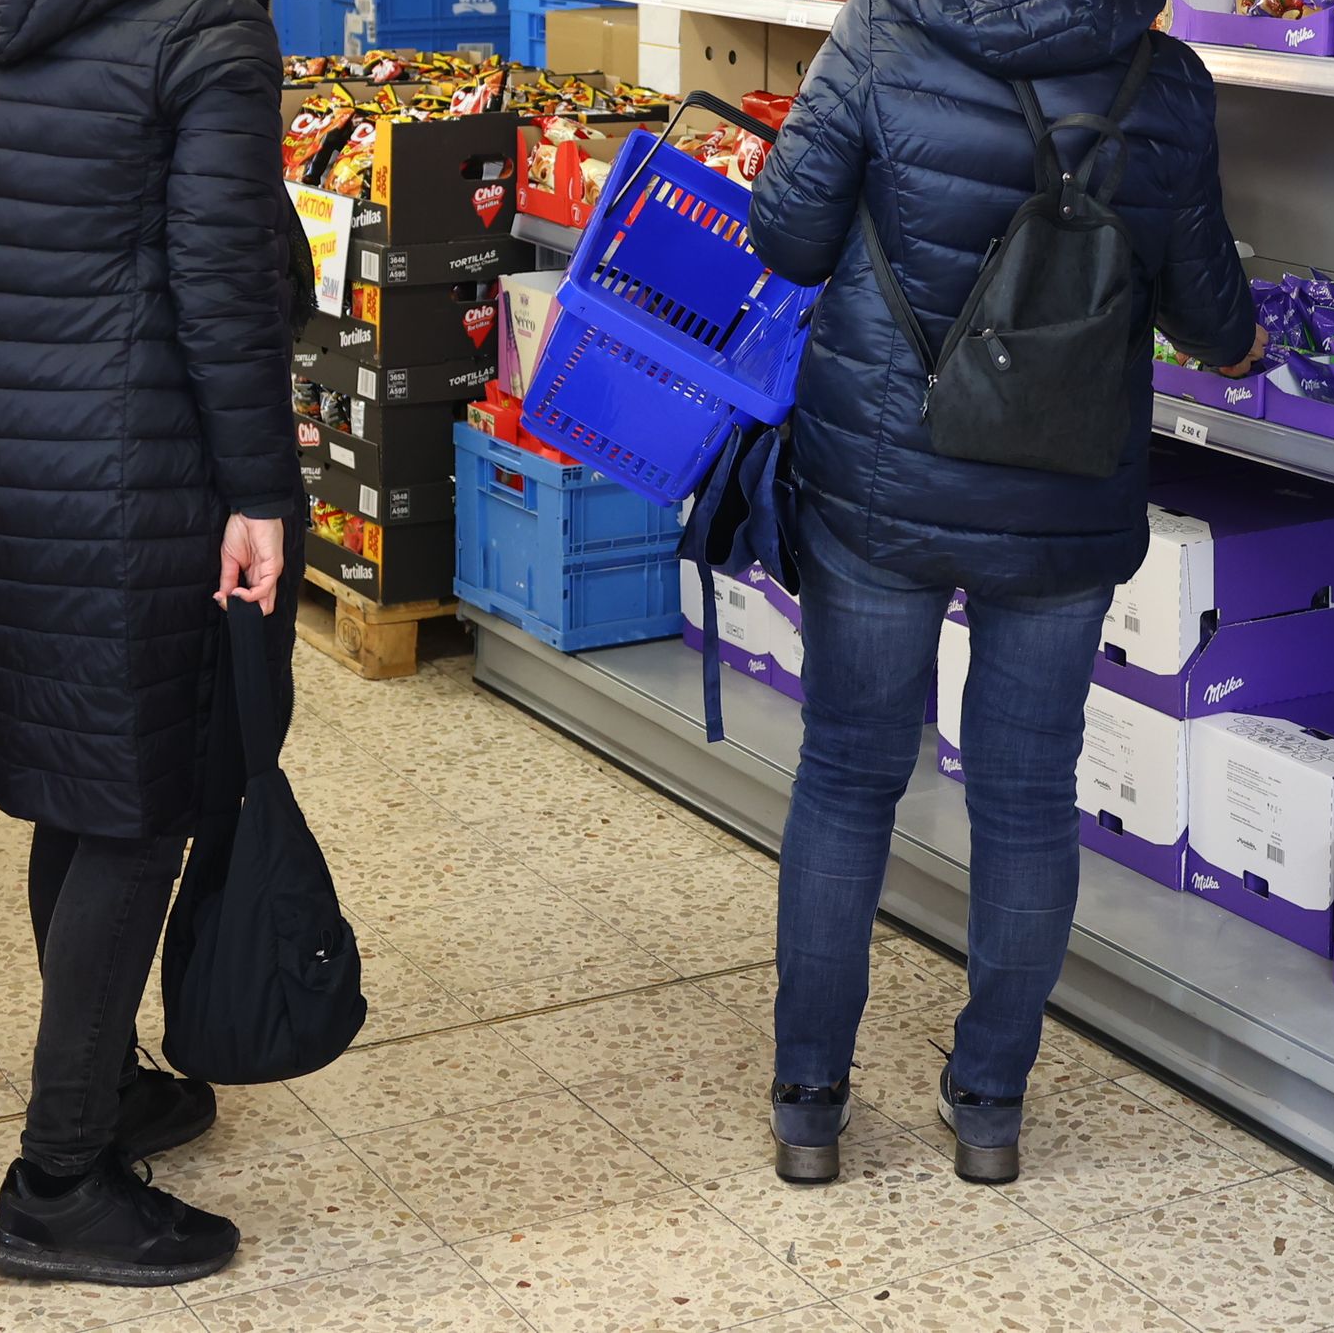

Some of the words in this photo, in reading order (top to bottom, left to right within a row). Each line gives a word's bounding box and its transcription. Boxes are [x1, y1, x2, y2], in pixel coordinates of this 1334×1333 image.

[1285, 28, 1316, 47] Milka
[475, 184, 504, 203] Chio
[296, 194, 334, 219] AKTION
[320, 238, 336, 254] nur
[449, 249, 497, 269] TORTILLAS
[465, 304, 494, 323] Chio
[340, 327, 372, 348] Tortillas
[449, 366, 495, 387] TORTILLAS
[1224, 386, 1253, 405] Milka
[298, 422, 320, 445] Chio
[1181, 424, 1196, 437] 2.50
[340, 562, 373, 580] Tortillas
[1204, 676, 1245, 704] Milka
[1192, 872, 1221, 892] Milka
